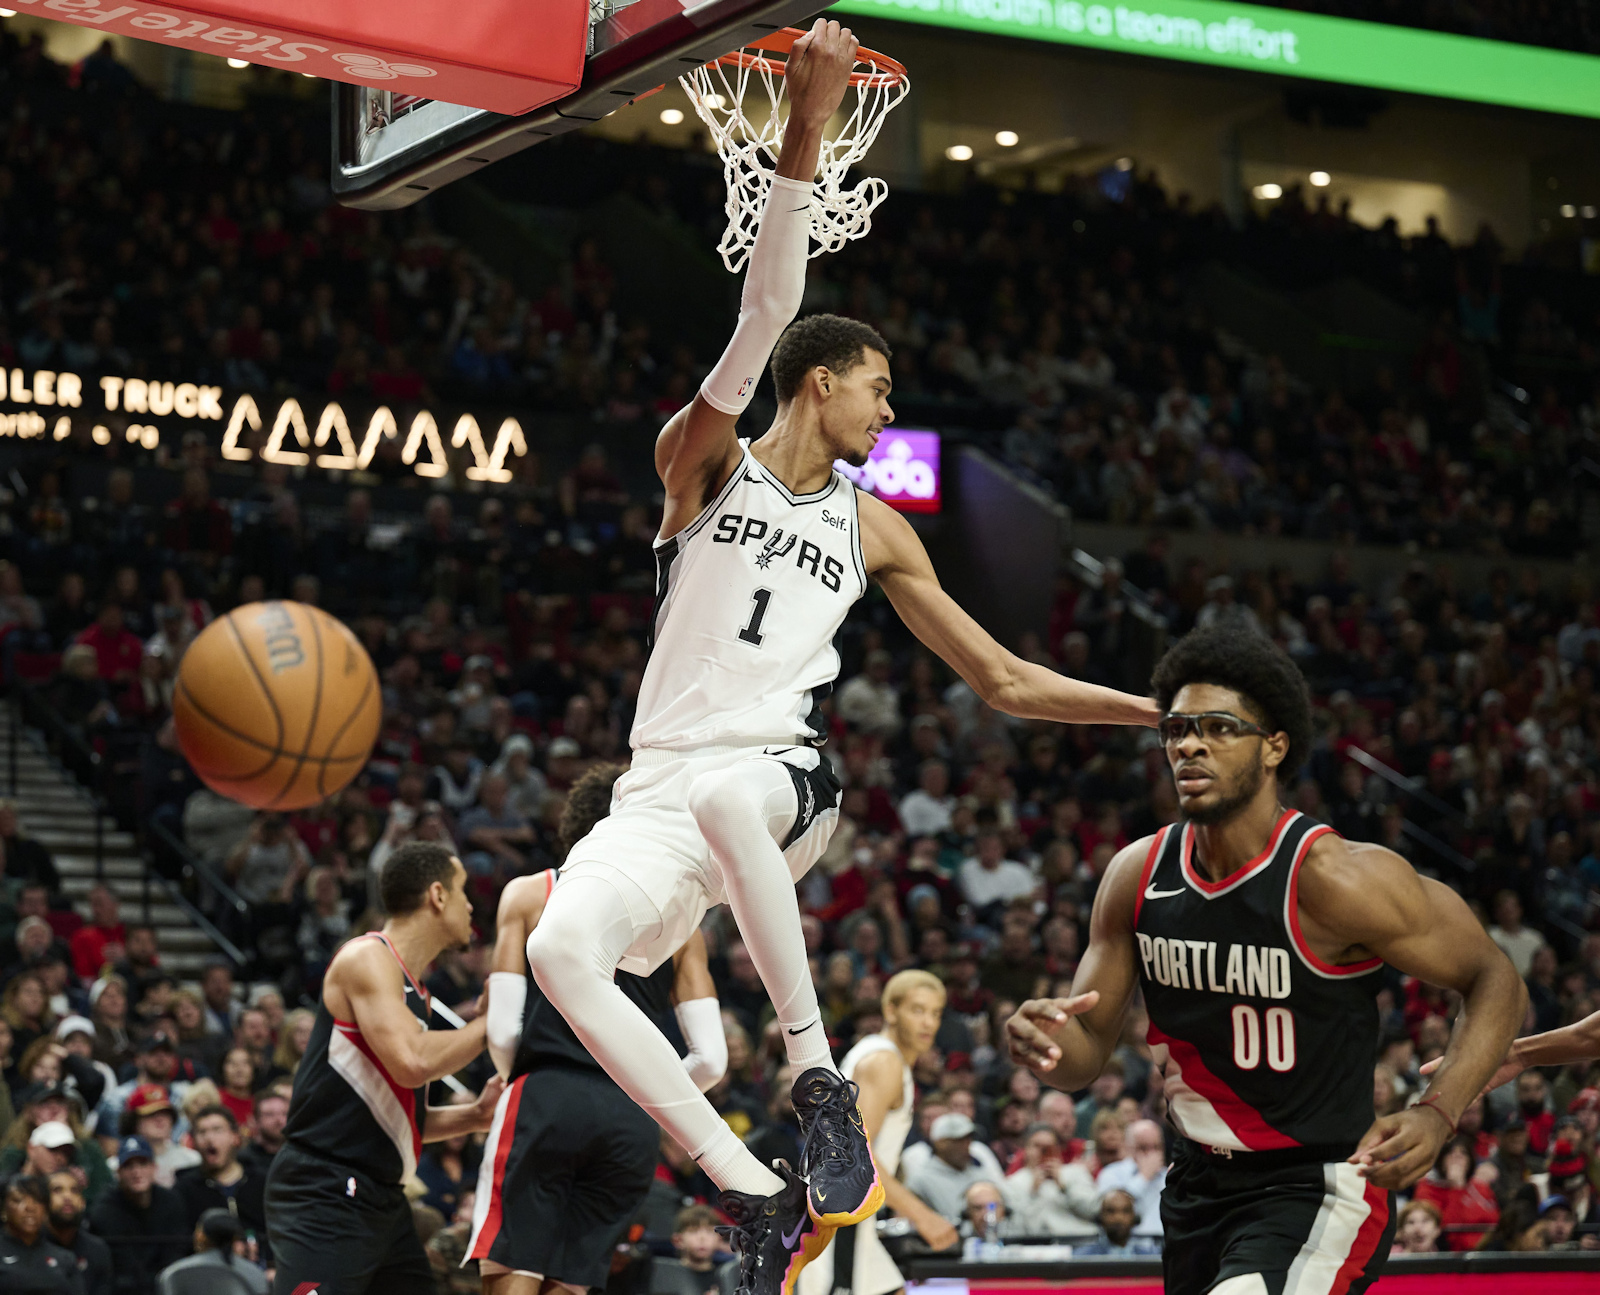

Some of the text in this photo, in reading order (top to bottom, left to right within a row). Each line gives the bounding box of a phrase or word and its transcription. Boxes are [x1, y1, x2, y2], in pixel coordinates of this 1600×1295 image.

[1115, 5, 1205, 49] team
[1206, 16, 1299, 64] effort
[99, 376, 224, 421] TRUCK
[820, 509, 848, 532] Self.
[712, 513, 845, 594] SPURS
[735, 585, 775, 649] 1
[1135, 931, 1292, 1000] PORTLAND
[1231, 1004, 1296, 1073] 00
